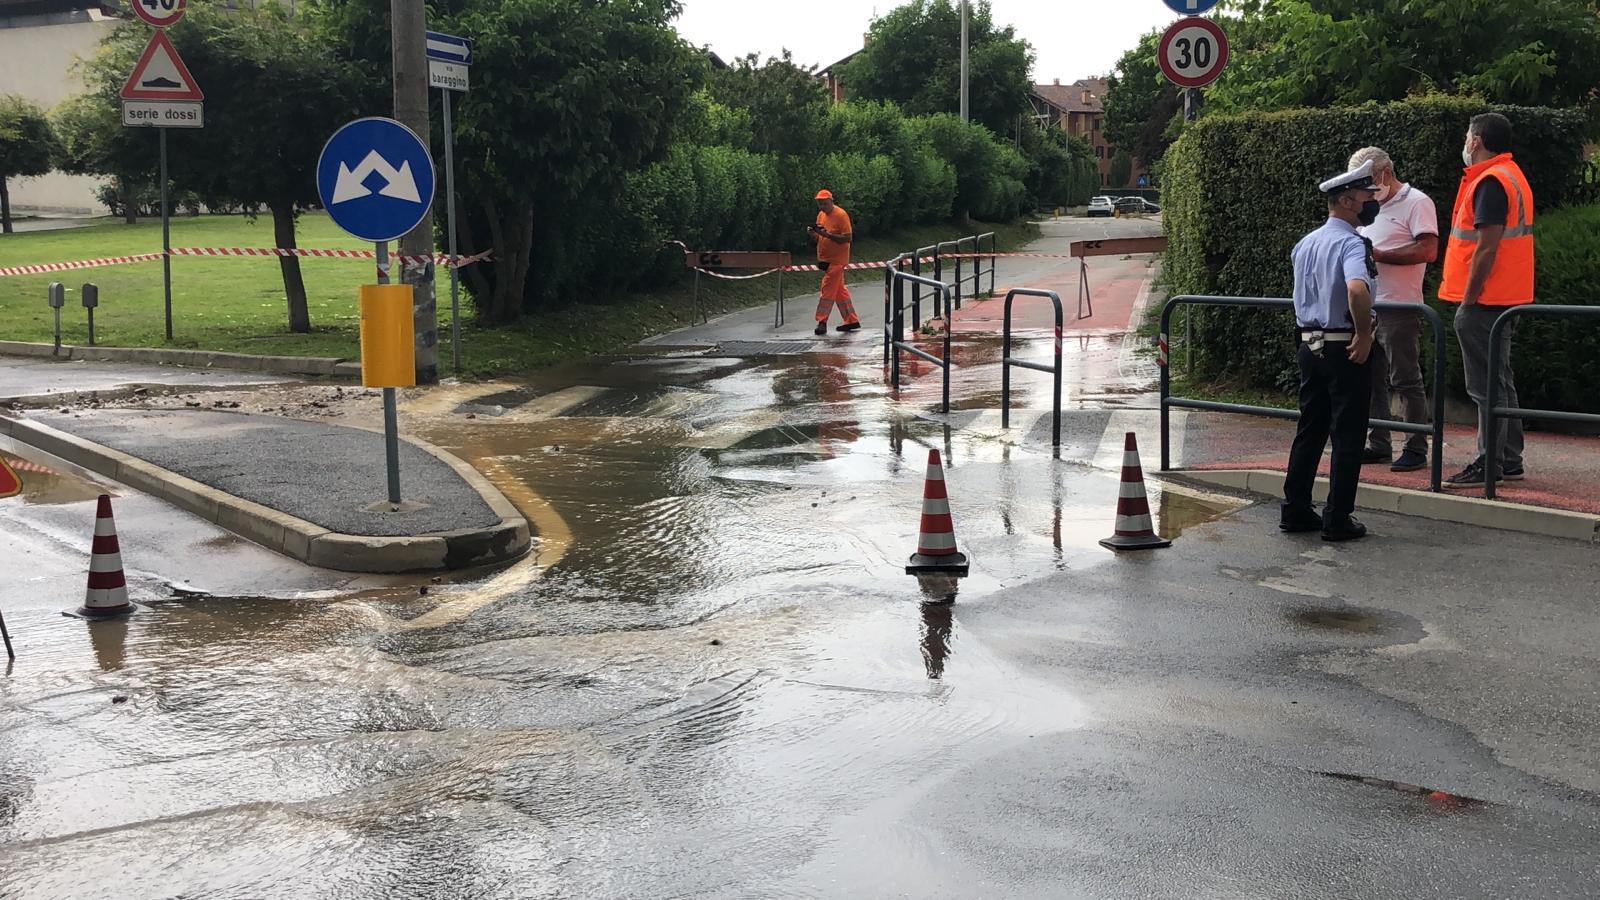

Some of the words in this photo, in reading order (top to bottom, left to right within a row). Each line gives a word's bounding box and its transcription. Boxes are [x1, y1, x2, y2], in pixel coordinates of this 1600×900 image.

[1175, 37, 1211, 69] 30
[432, 72, 467, 87] baraggino
[129, 108, 159, 119] serie
[165, 108, 197, 120] dossi
